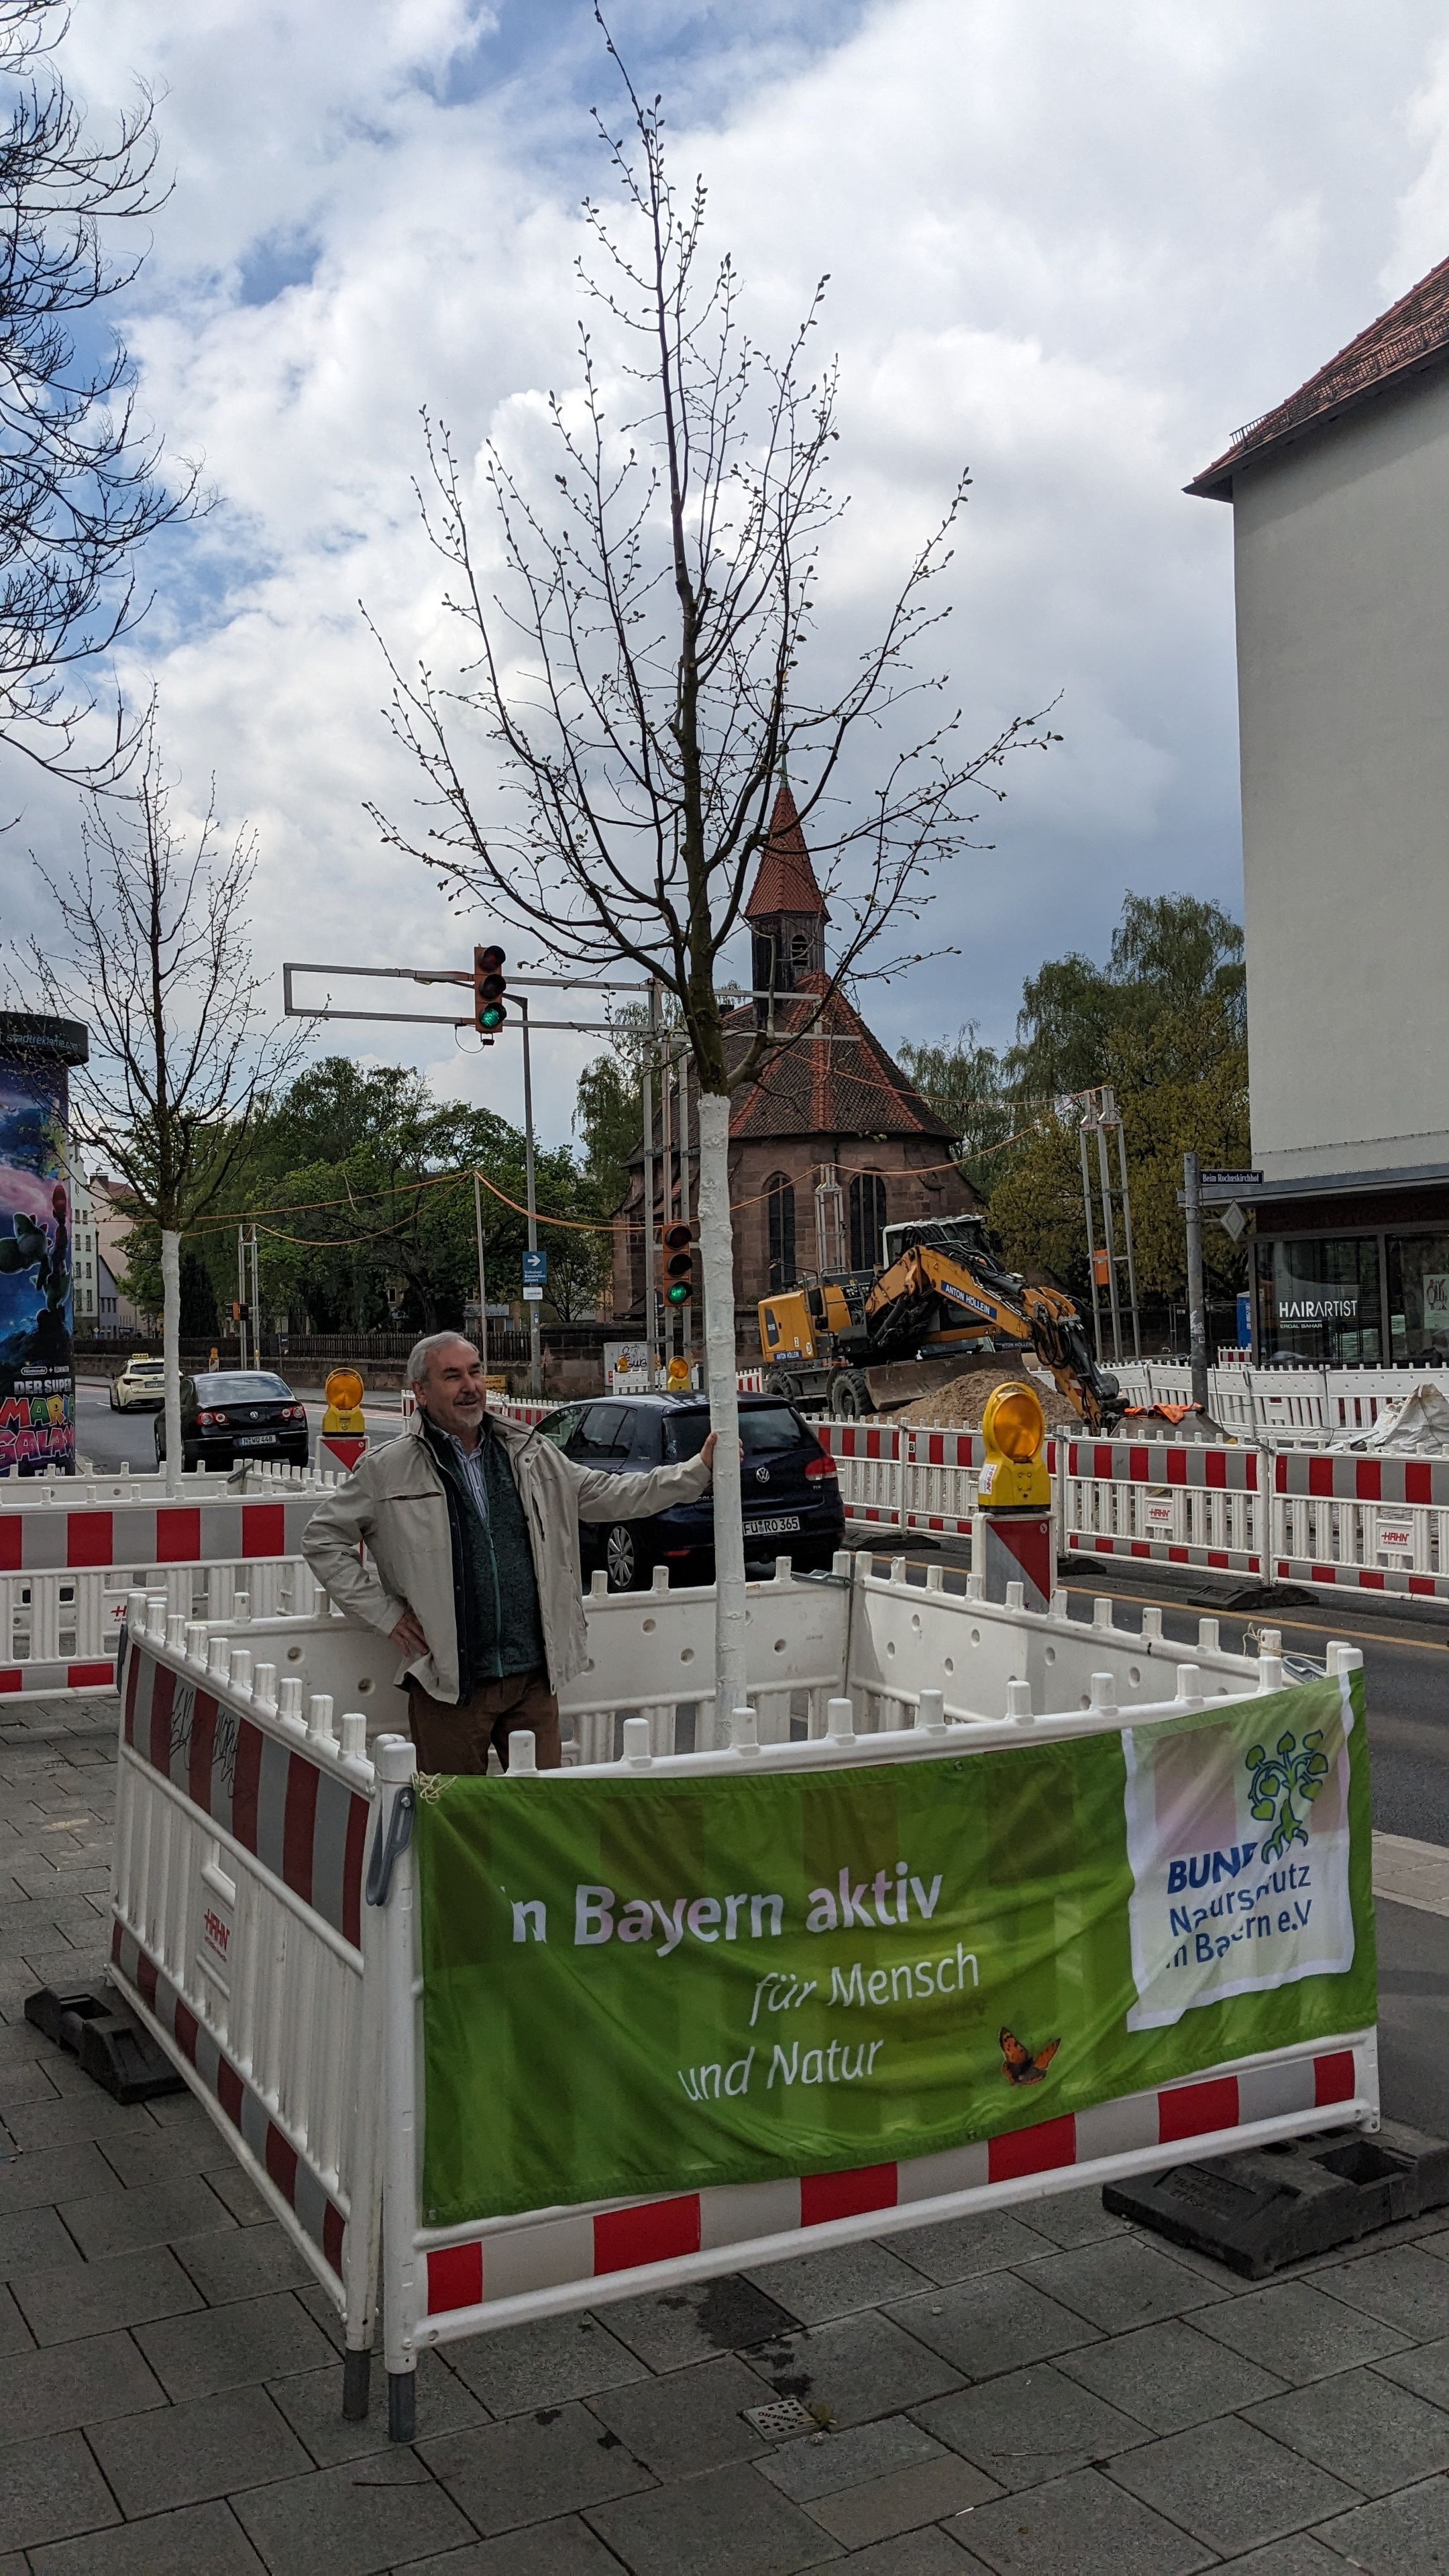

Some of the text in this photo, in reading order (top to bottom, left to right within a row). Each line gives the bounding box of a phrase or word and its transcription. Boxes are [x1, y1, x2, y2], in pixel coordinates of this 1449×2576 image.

[1202, 1173, 1217, 1182] Beim
[945, 1284, 965, 1301] ANTON
[1279, 1300, 1357, 1318] HAIRARTIST
[13, 1380, 43, 1395] DER
[1148, 1508, 1171, 1517] HAHN
[764, 1519, 777, 1533] RO
[780, 1517, 799, 1531] 365
[1381, 1532, 1409, 1542] HAHN
[574, 1884, 784, 1957] Bayern
[806, 1861, 943, 1933] aktiv
[749, 1942, 979, 2027] für Mensch
[678, 2039, 884, 2101] und Natur
